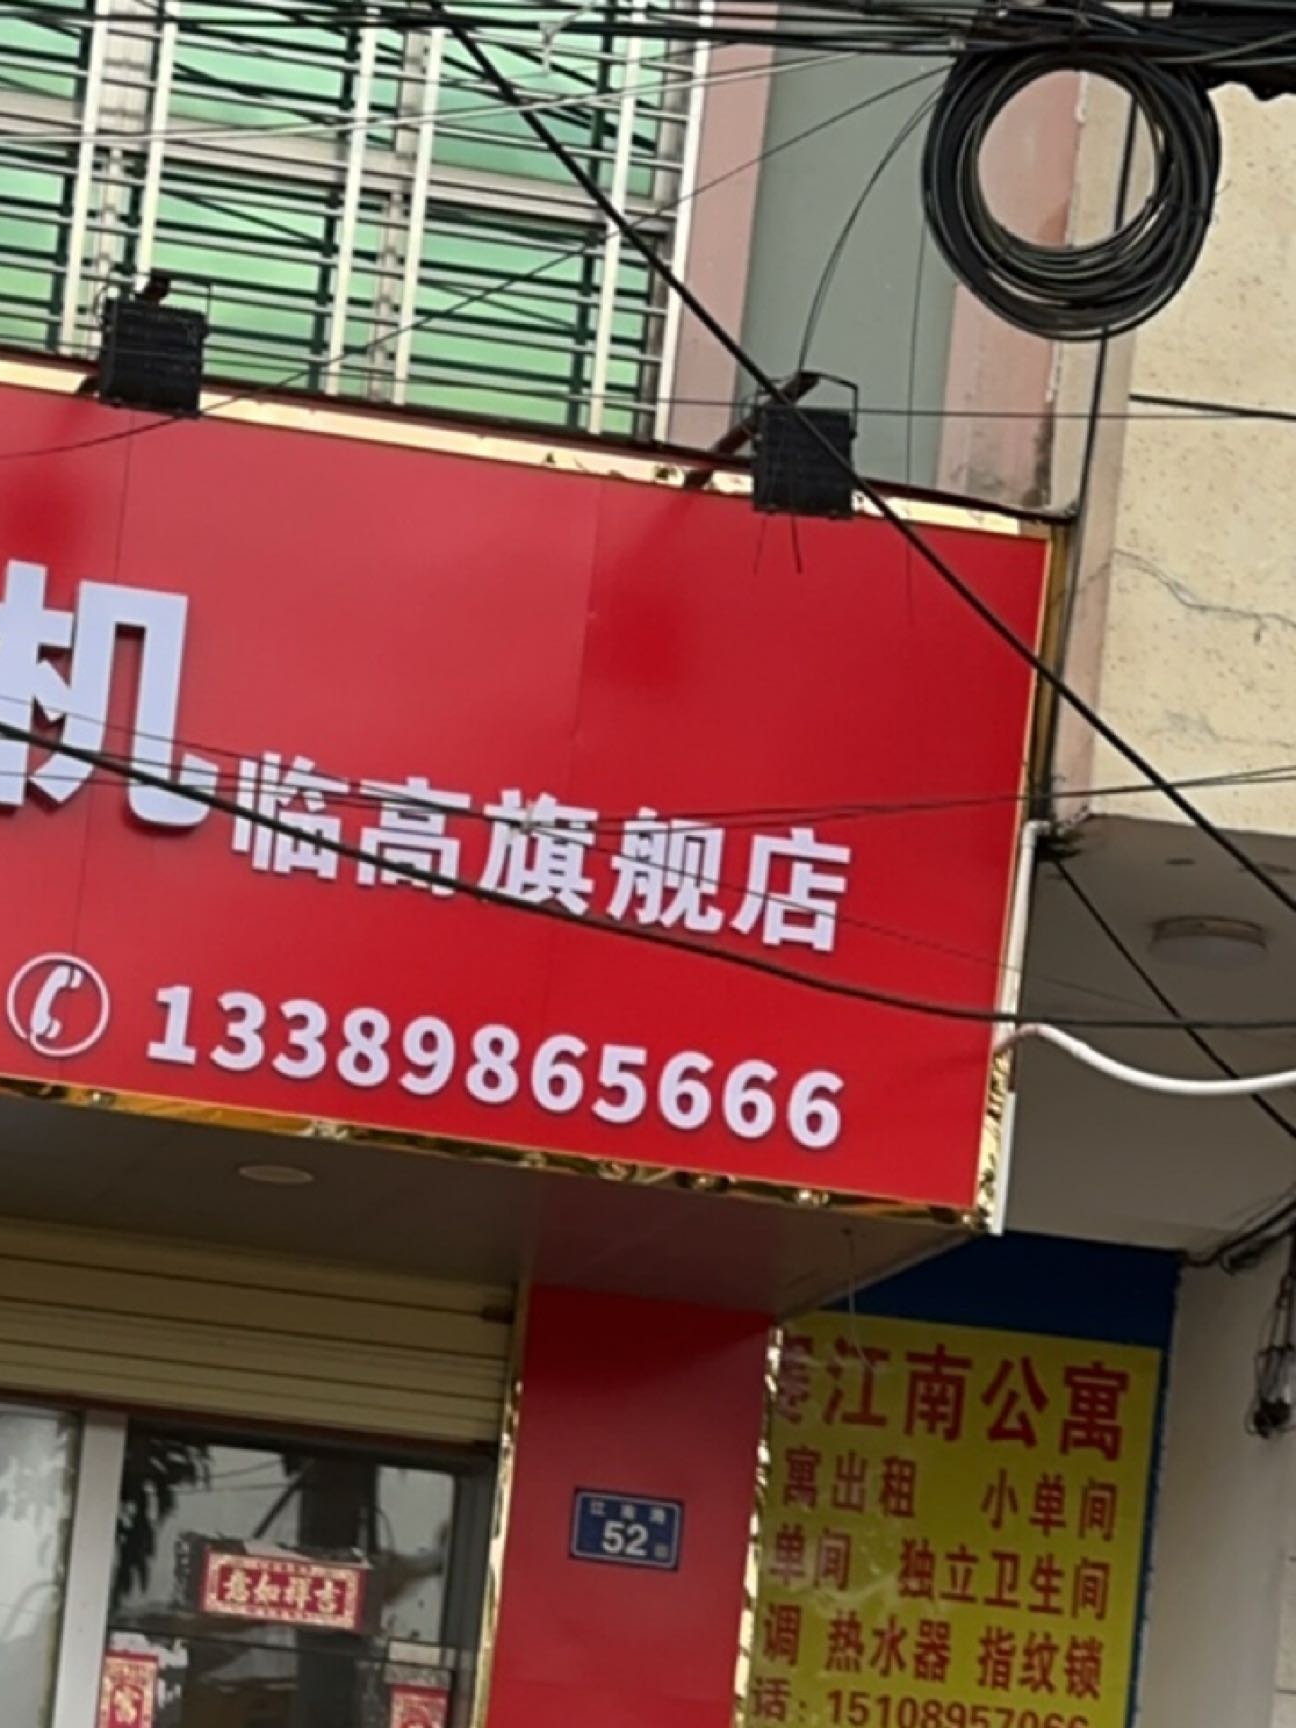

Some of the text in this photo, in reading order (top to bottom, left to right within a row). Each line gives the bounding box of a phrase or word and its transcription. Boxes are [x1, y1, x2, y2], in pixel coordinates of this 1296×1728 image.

[232, 751, 851, 953] 临高旗舰店
[146, 984, 845, 1151] 13389865666
[602, 1520, 648, 1556] 52
[782, 1444, 1116, 1541] 寓出租 小单间
[900, 1539, 1109, 1620] 独立卫生间
[825, 1610, 951, 1682] 热水器
[977, 1626, 1101, 1700] 指纹锁
